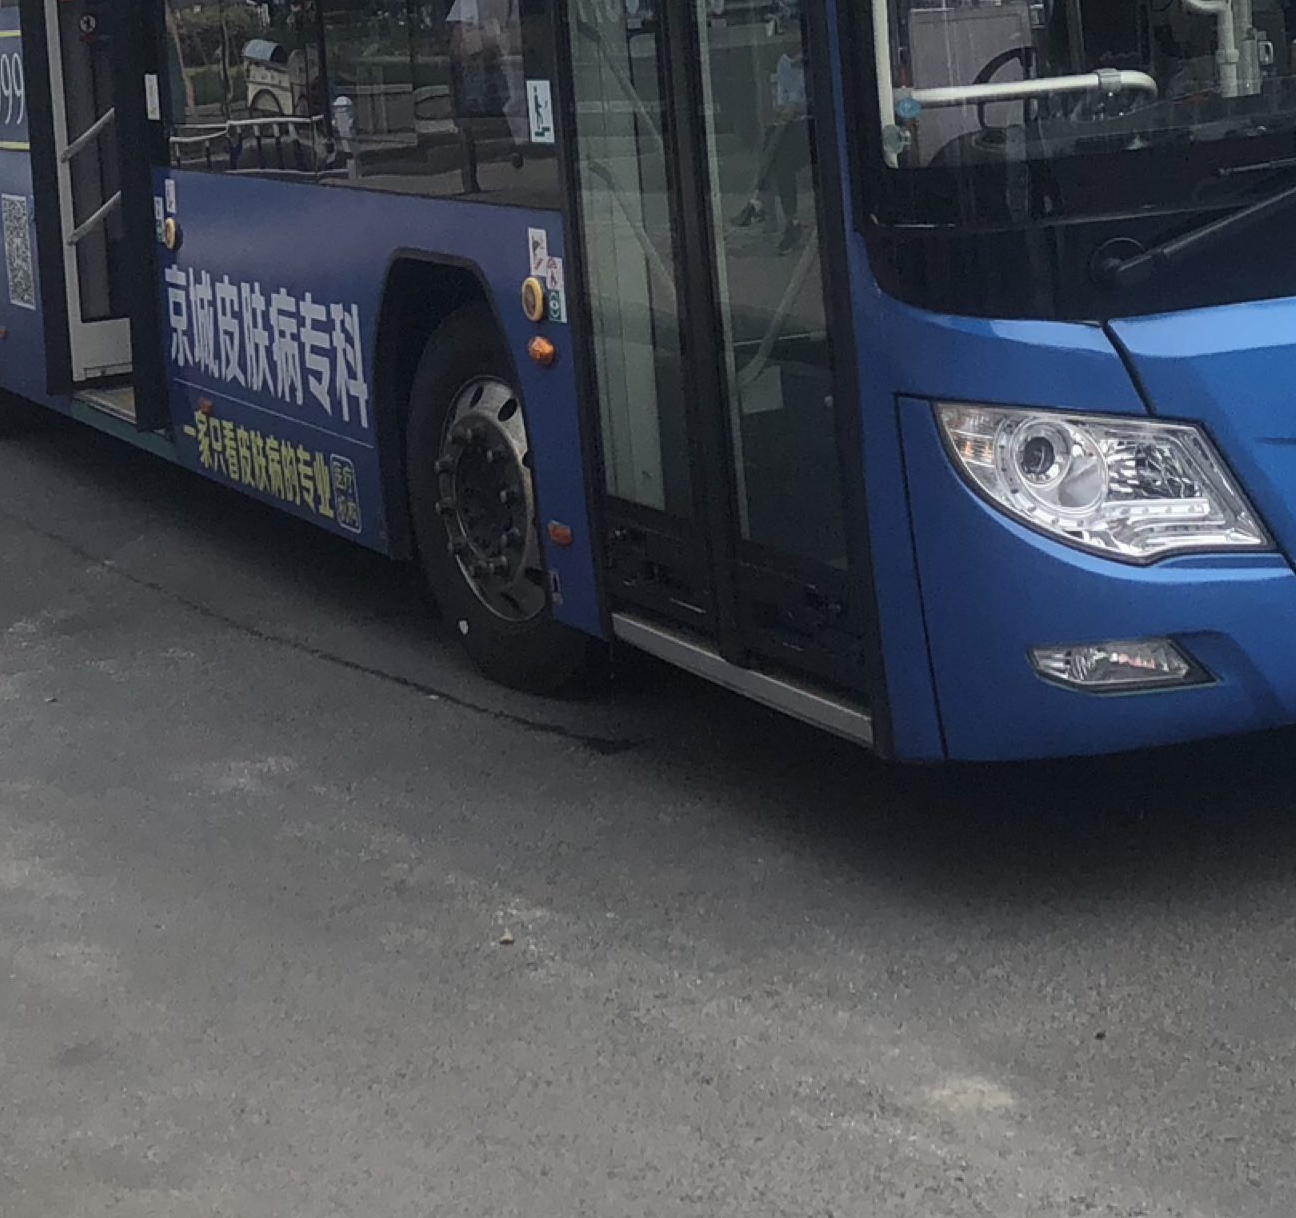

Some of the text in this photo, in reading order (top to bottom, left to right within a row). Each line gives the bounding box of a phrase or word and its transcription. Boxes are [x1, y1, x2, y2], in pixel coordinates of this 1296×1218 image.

[164, 263, 370, 429] 京城皮肤病专科
[183, 409, 335, 519] 一家只看皮肤病的专业
